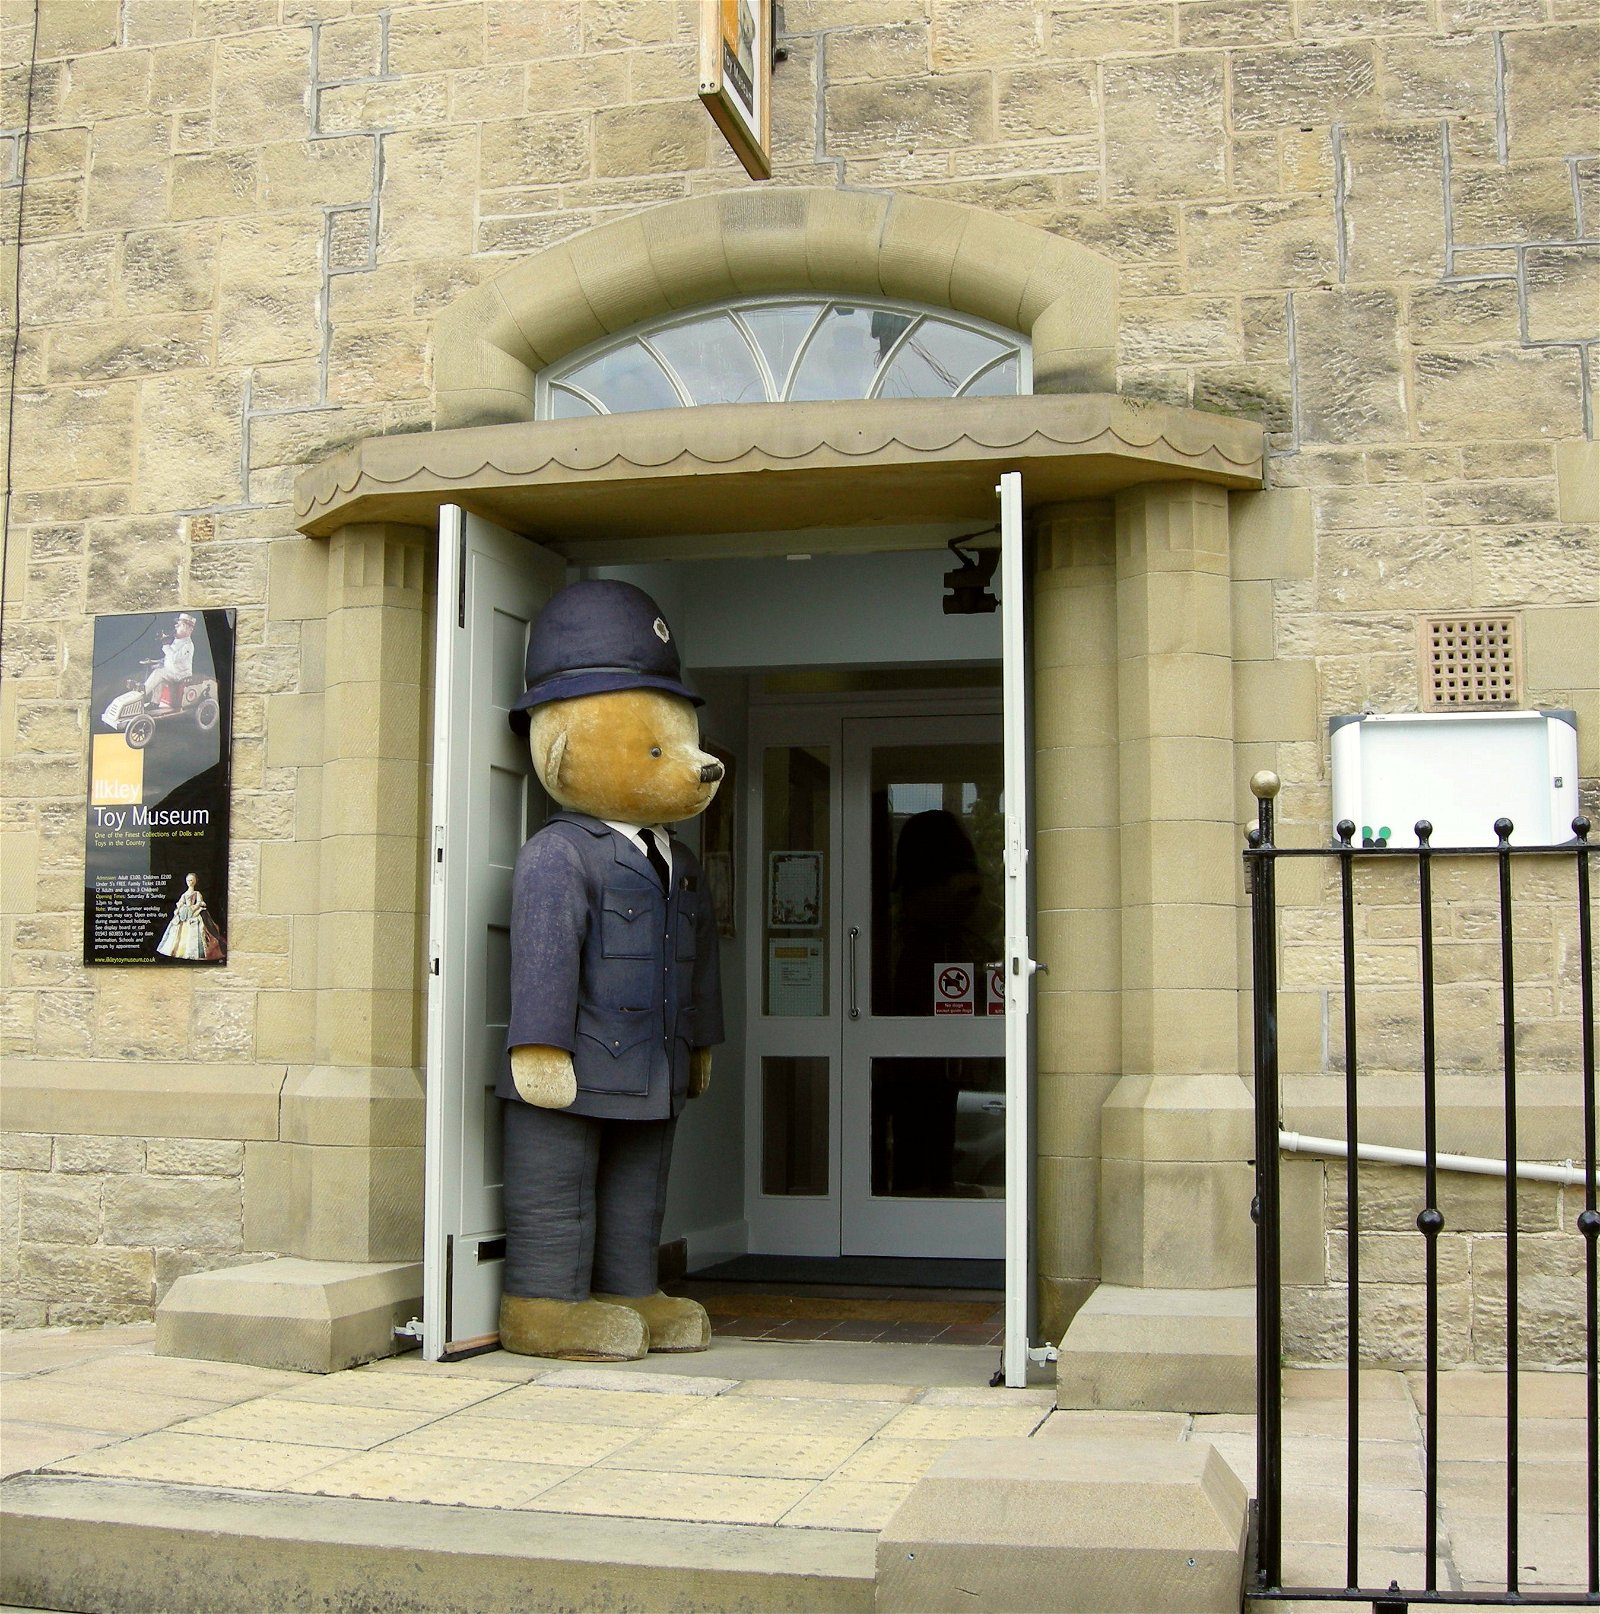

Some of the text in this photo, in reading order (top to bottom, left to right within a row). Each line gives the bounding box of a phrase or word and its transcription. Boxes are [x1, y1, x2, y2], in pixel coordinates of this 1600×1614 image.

[723, 46, 732, 73] Toy
[95, 779, 140, 804] Ilkley
[94, 806, 209, 831] Toy Museum
